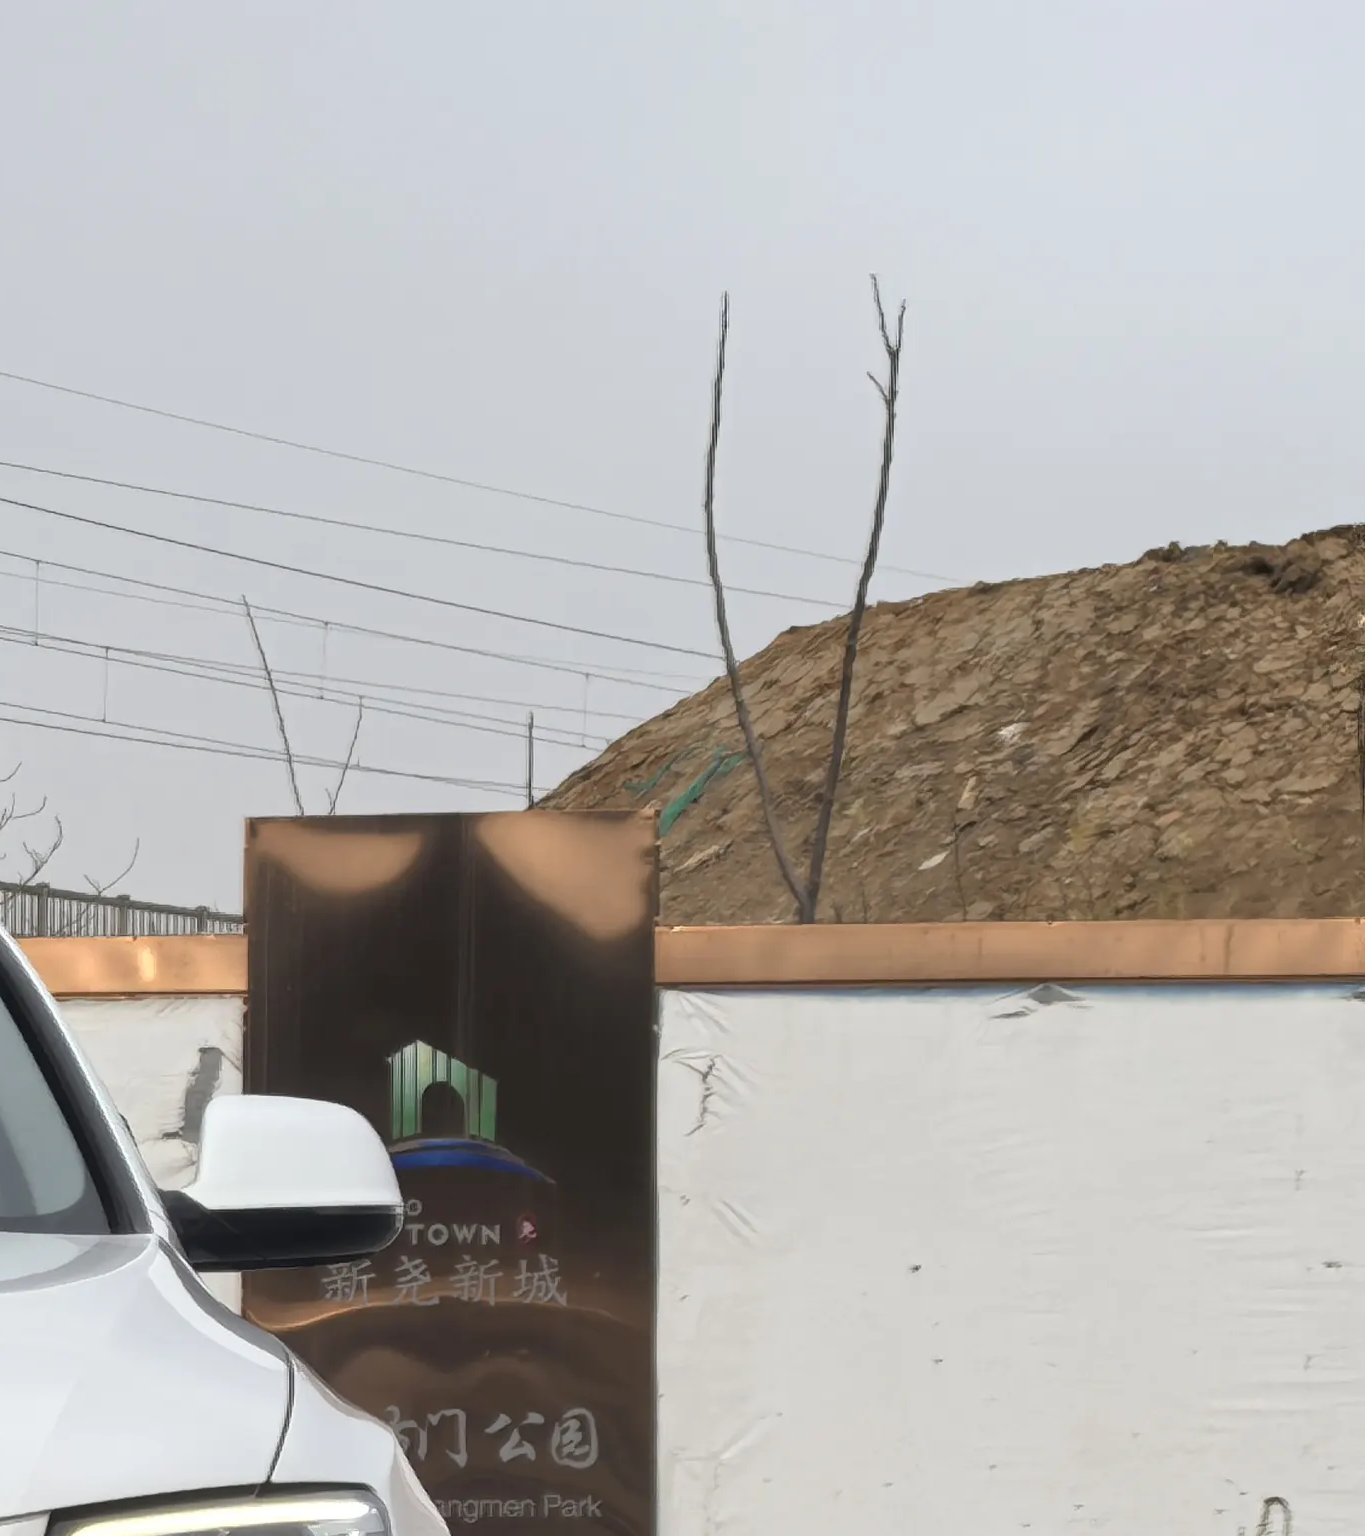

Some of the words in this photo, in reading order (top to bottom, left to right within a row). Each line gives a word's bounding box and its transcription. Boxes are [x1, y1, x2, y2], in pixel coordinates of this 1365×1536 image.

[405, 1223, 501, 1246] TOWN
[321, 1254, 568, 1306] 新尧新城
[543, 1494, 603, 1518] Park
